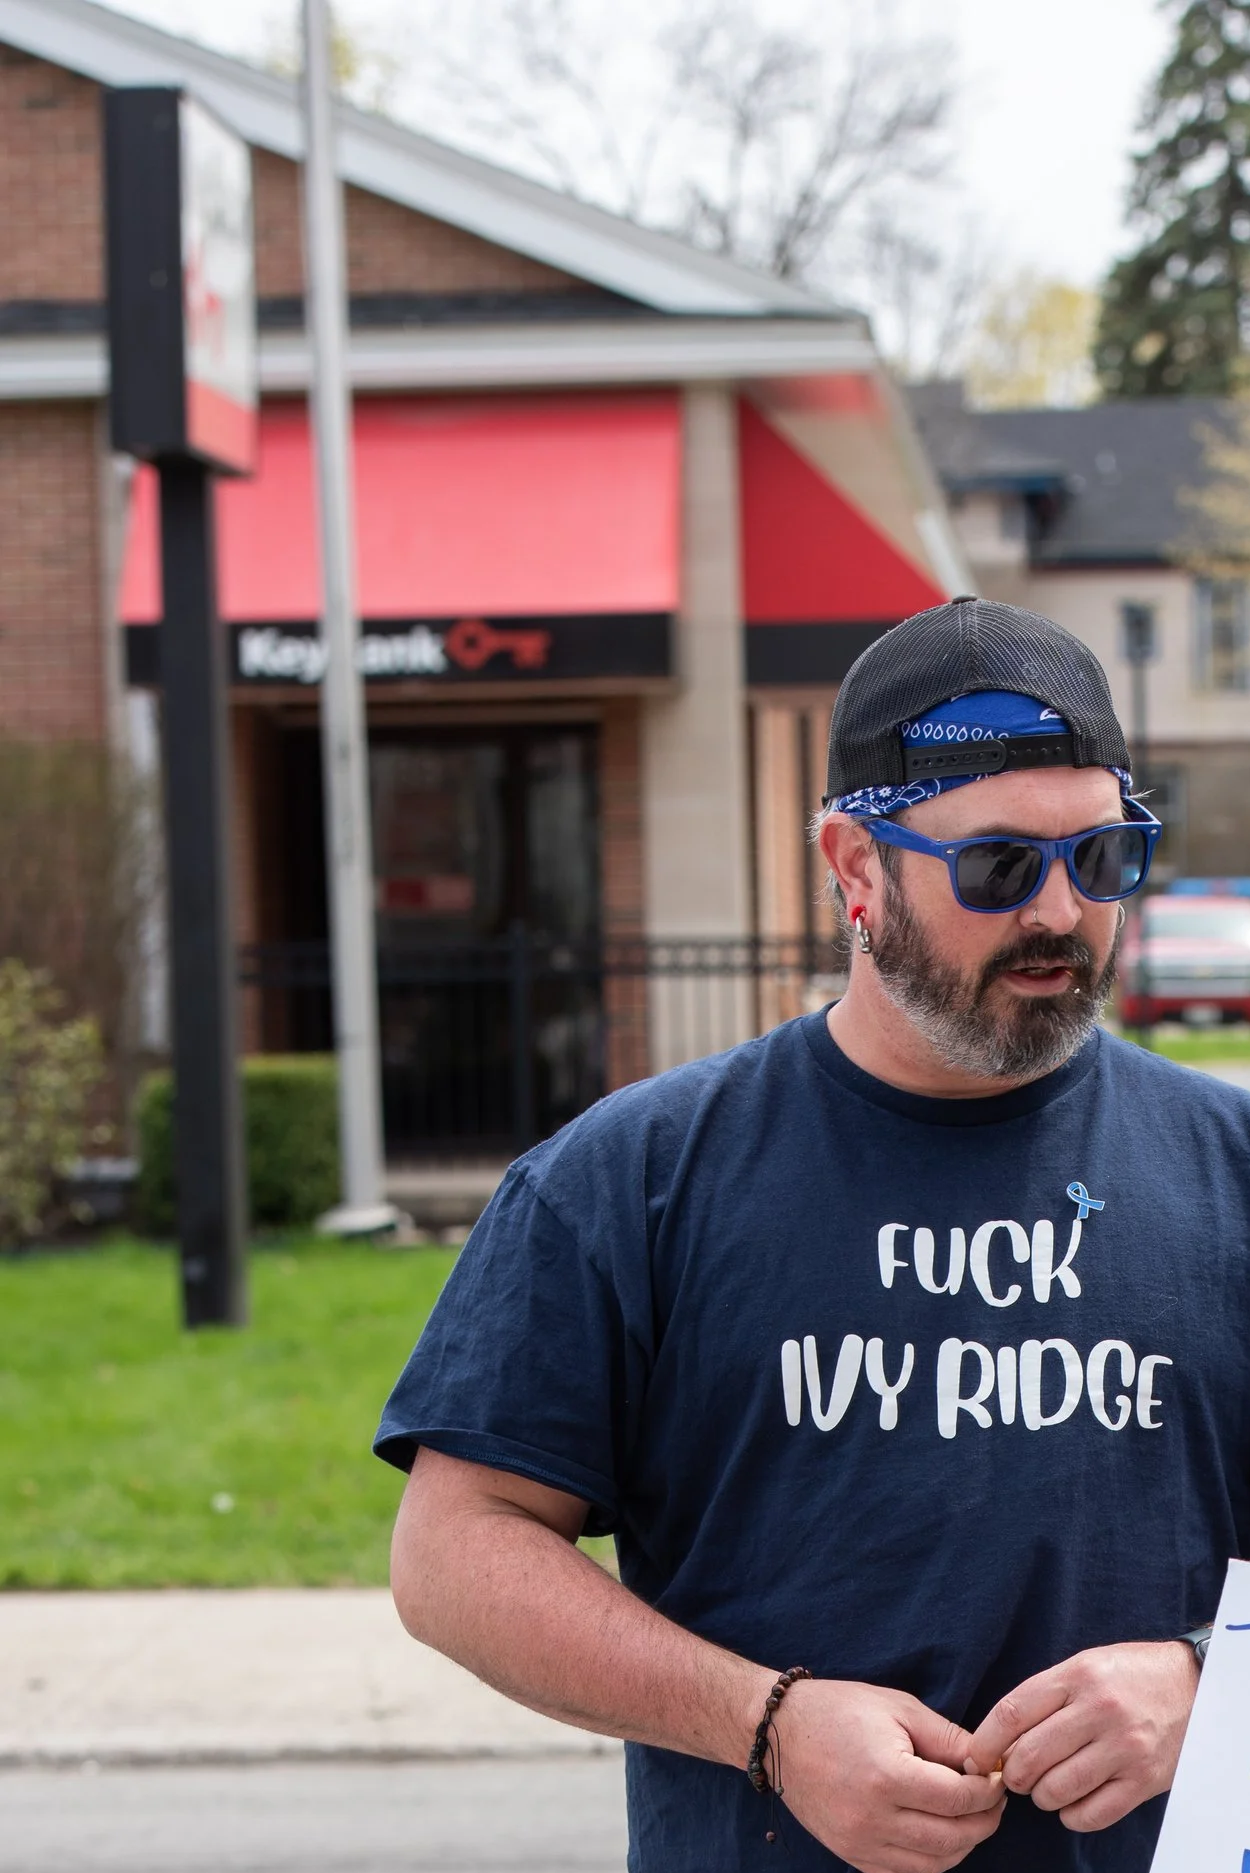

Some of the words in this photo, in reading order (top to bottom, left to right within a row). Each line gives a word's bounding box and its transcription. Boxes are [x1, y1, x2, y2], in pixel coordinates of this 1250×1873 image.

[239, 626, 446, 684] Keyank
[878, 1219, 1082, 1307] FUCK
[781, 1334, 914, 1432] IVY
[937, 1337, 1173, 1439] RIDGE
